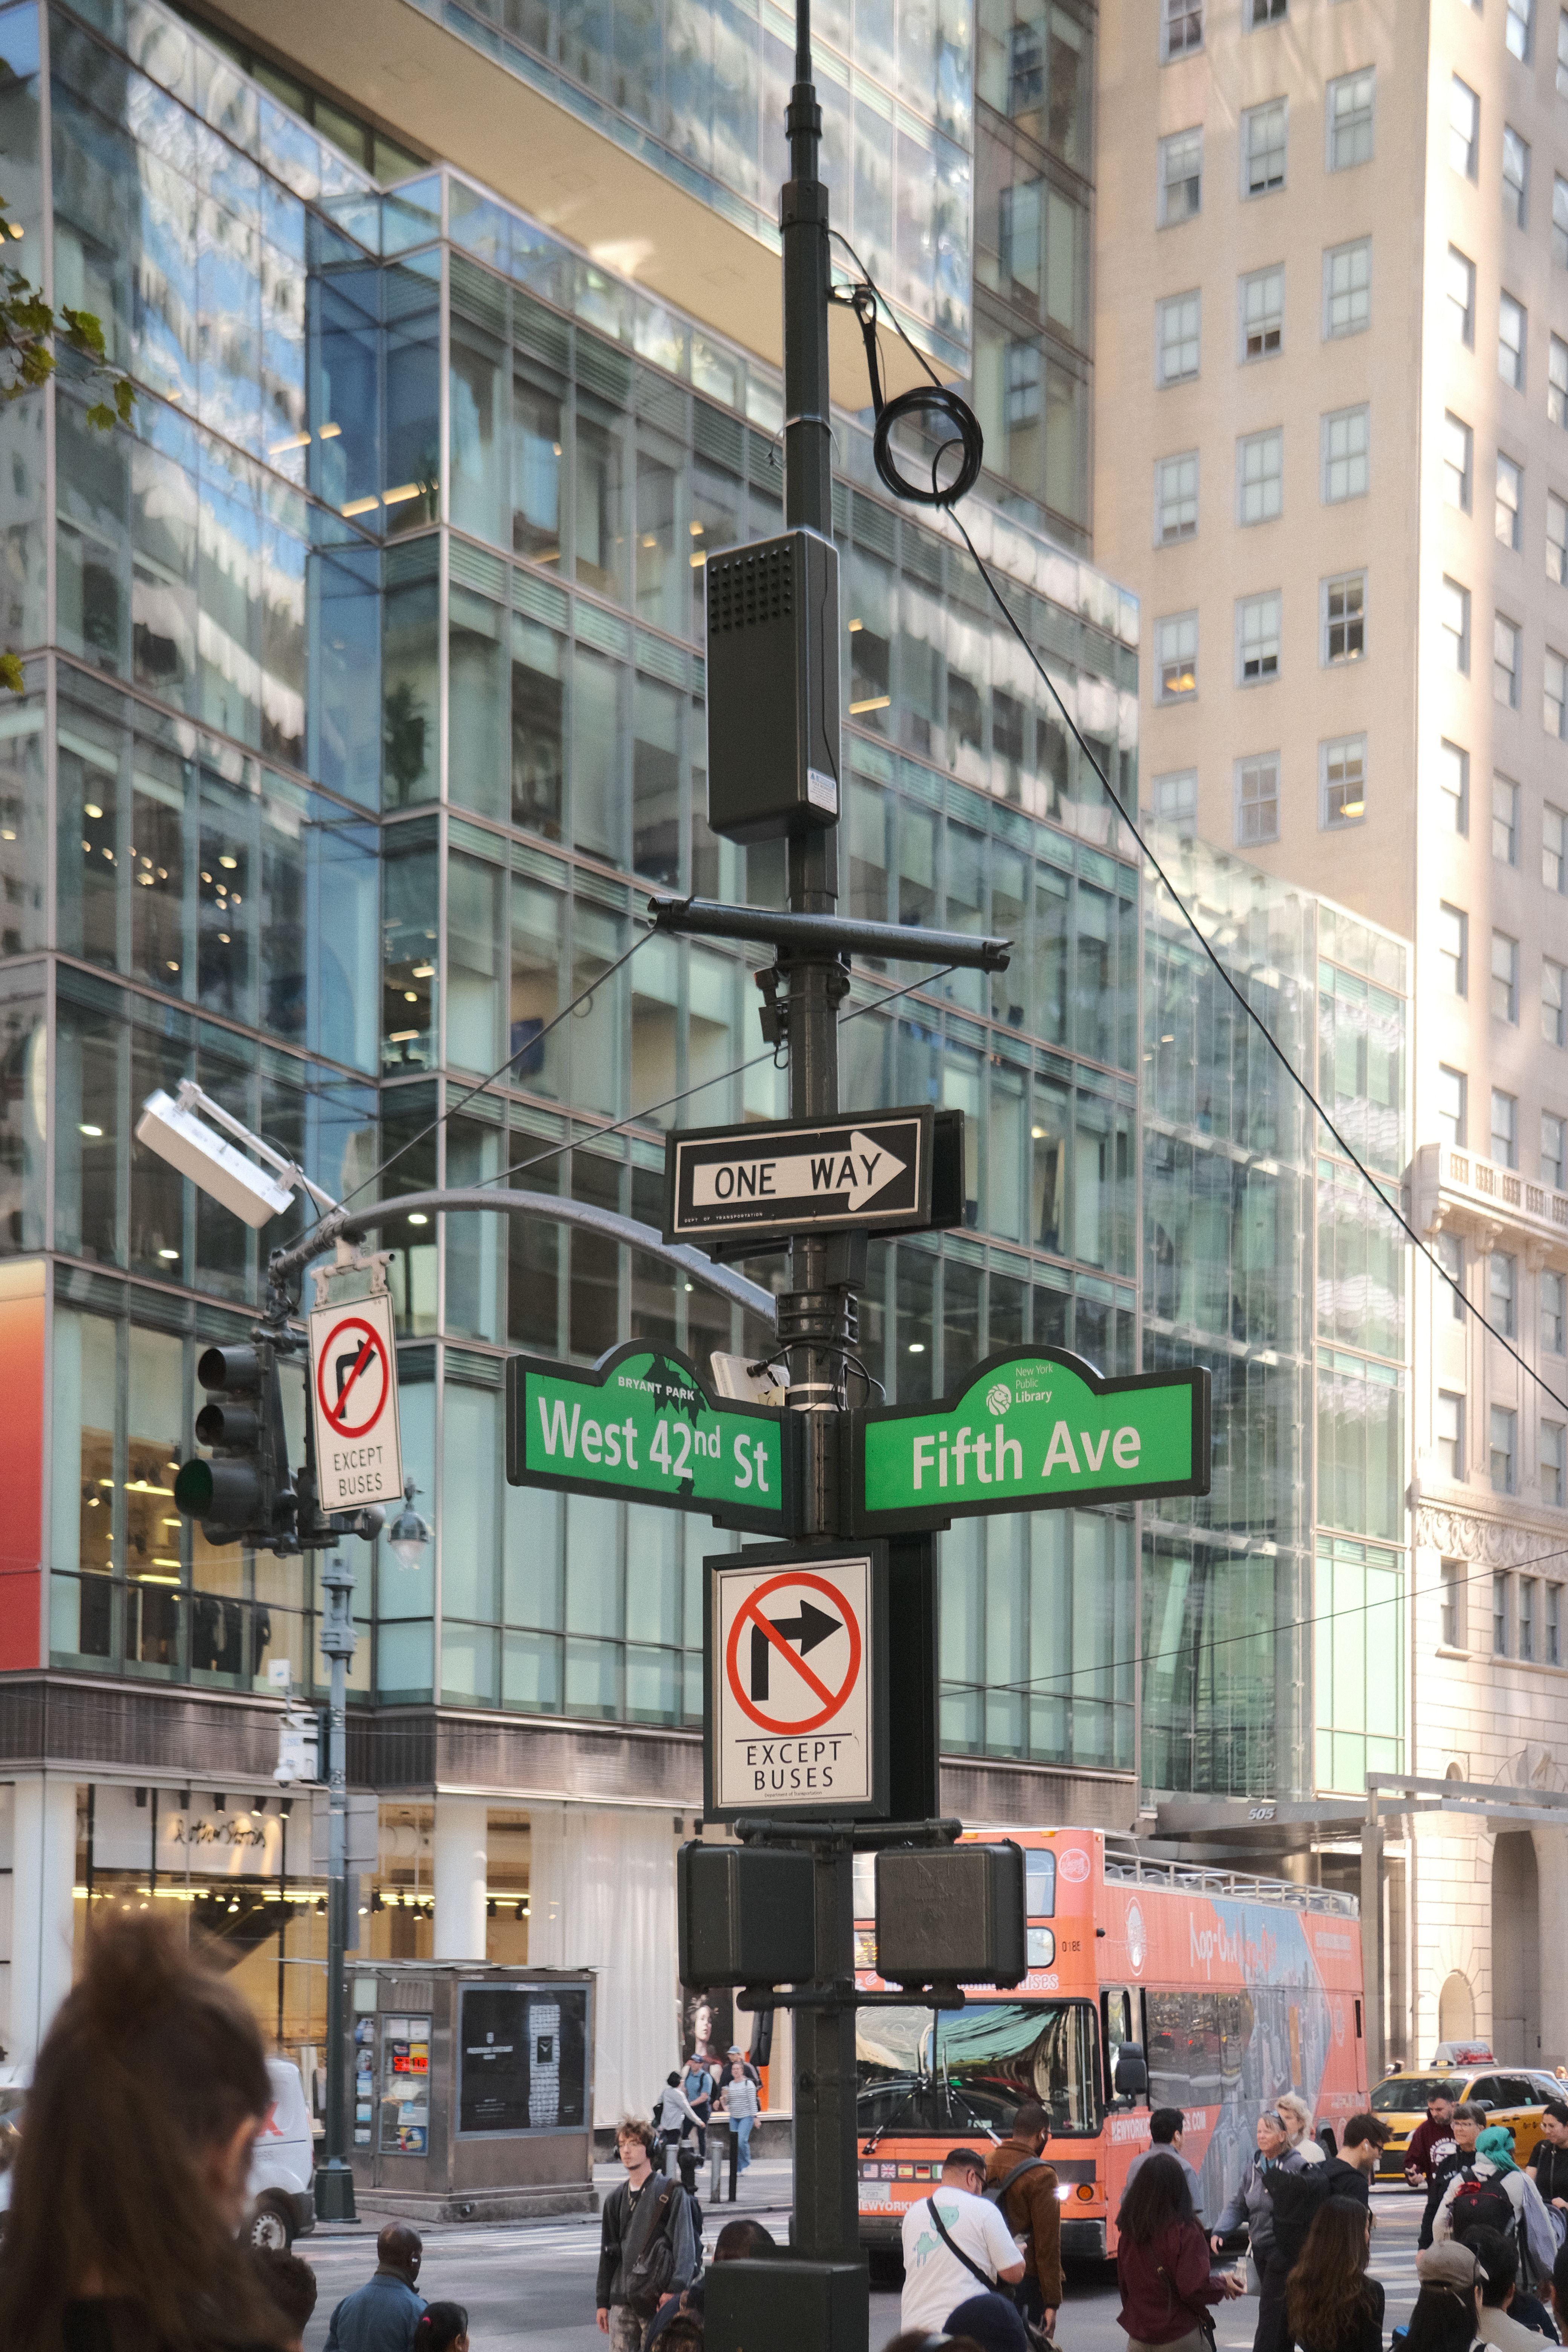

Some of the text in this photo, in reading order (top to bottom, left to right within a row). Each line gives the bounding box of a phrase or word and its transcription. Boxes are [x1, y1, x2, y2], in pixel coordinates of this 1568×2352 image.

[715, 1153, 882, 1199] ONE WAY
[1016, 1363, 1053, 1377] New York
[617, 1375, 695, 1401] BRYANT PARK
[1016, 1378, 1038, 1389] Public
[1015, 1390, 1052, 1403] Library
[538, 1396, 769, 1492] West 42nd St
[913, 1420, 1142, 1490] Fifth Ave
[333, 1445, 383, 1472] EXCEPT
[338, 1472, 383, 1497] BUSES
[747, 1740, 842, 1766] EXCEPT
[754, 1766, 833, 1791] BUSES
[1248, 1808, 1276, 1820] 505
[1061, 1941, 1081, 1952] 0185
